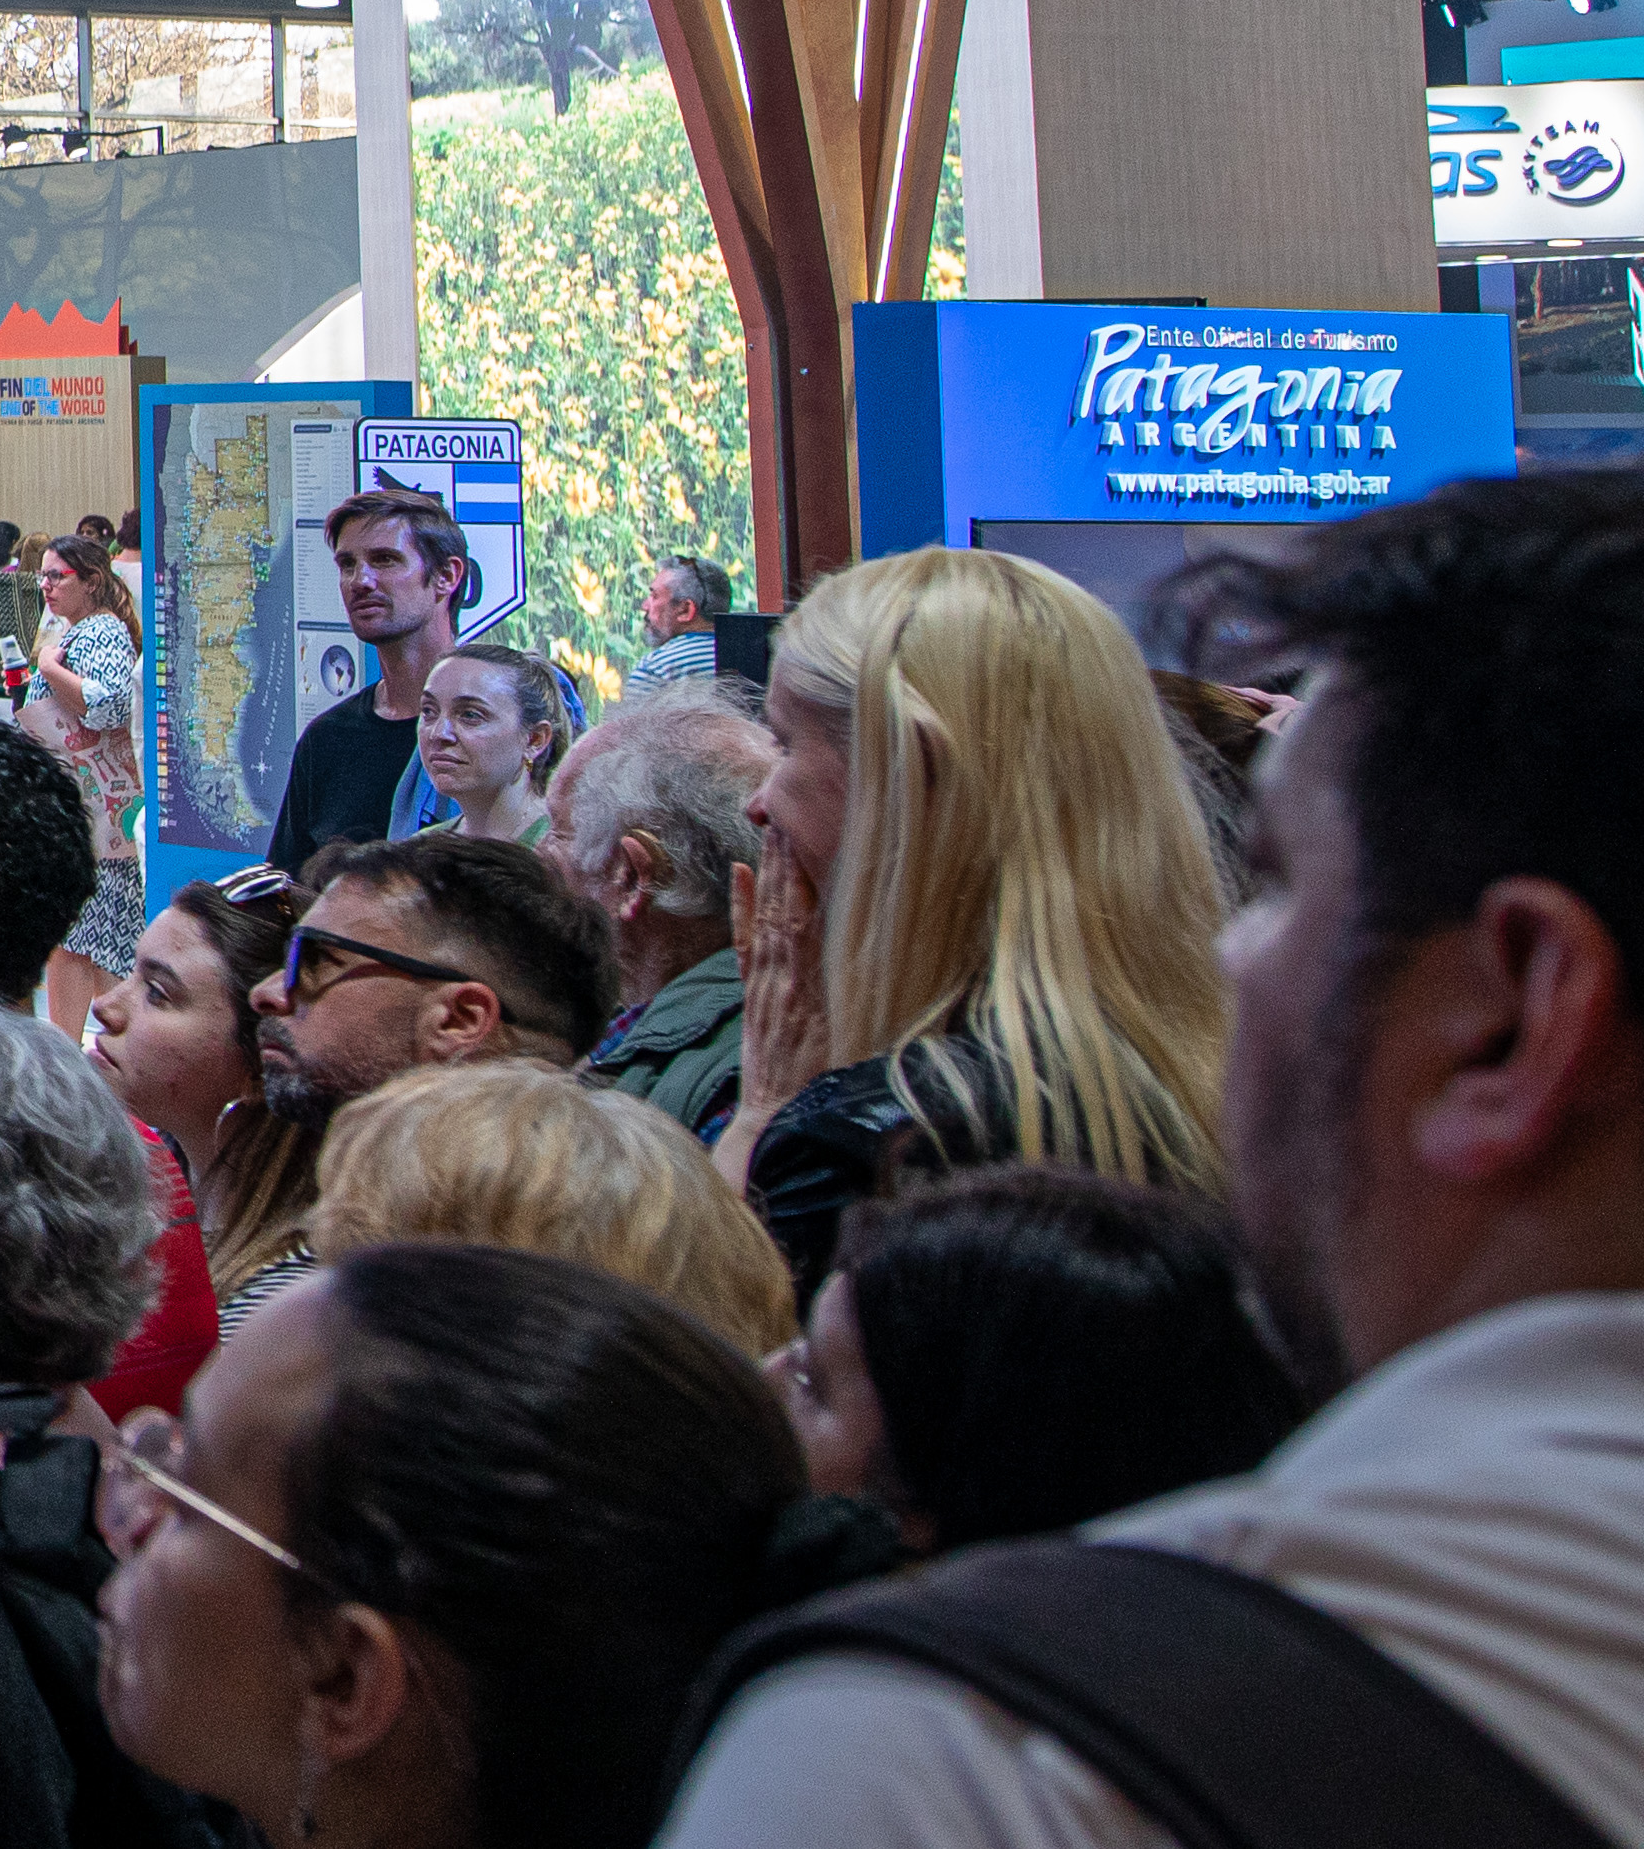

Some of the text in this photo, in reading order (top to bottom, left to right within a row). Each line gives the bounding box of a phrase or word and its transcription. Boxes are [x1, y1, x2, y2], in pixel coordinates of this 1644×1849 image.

[1146, 325, 1398, 352] Ente Oficial de Turismo
[0, 375, 105, 398] FIN DEL MUNDO
[1071, 323, 1403, 454] Patagonia
[22, 399, 36, 416] OF
[60, 398, 106, 416] WORLD
[374, 433, 505, 459] PATAGONIA
[1100, 421, 1397, 449] ARGENTINA
[1108, 468, 1391, 501] www.patagonia.gob.ar
